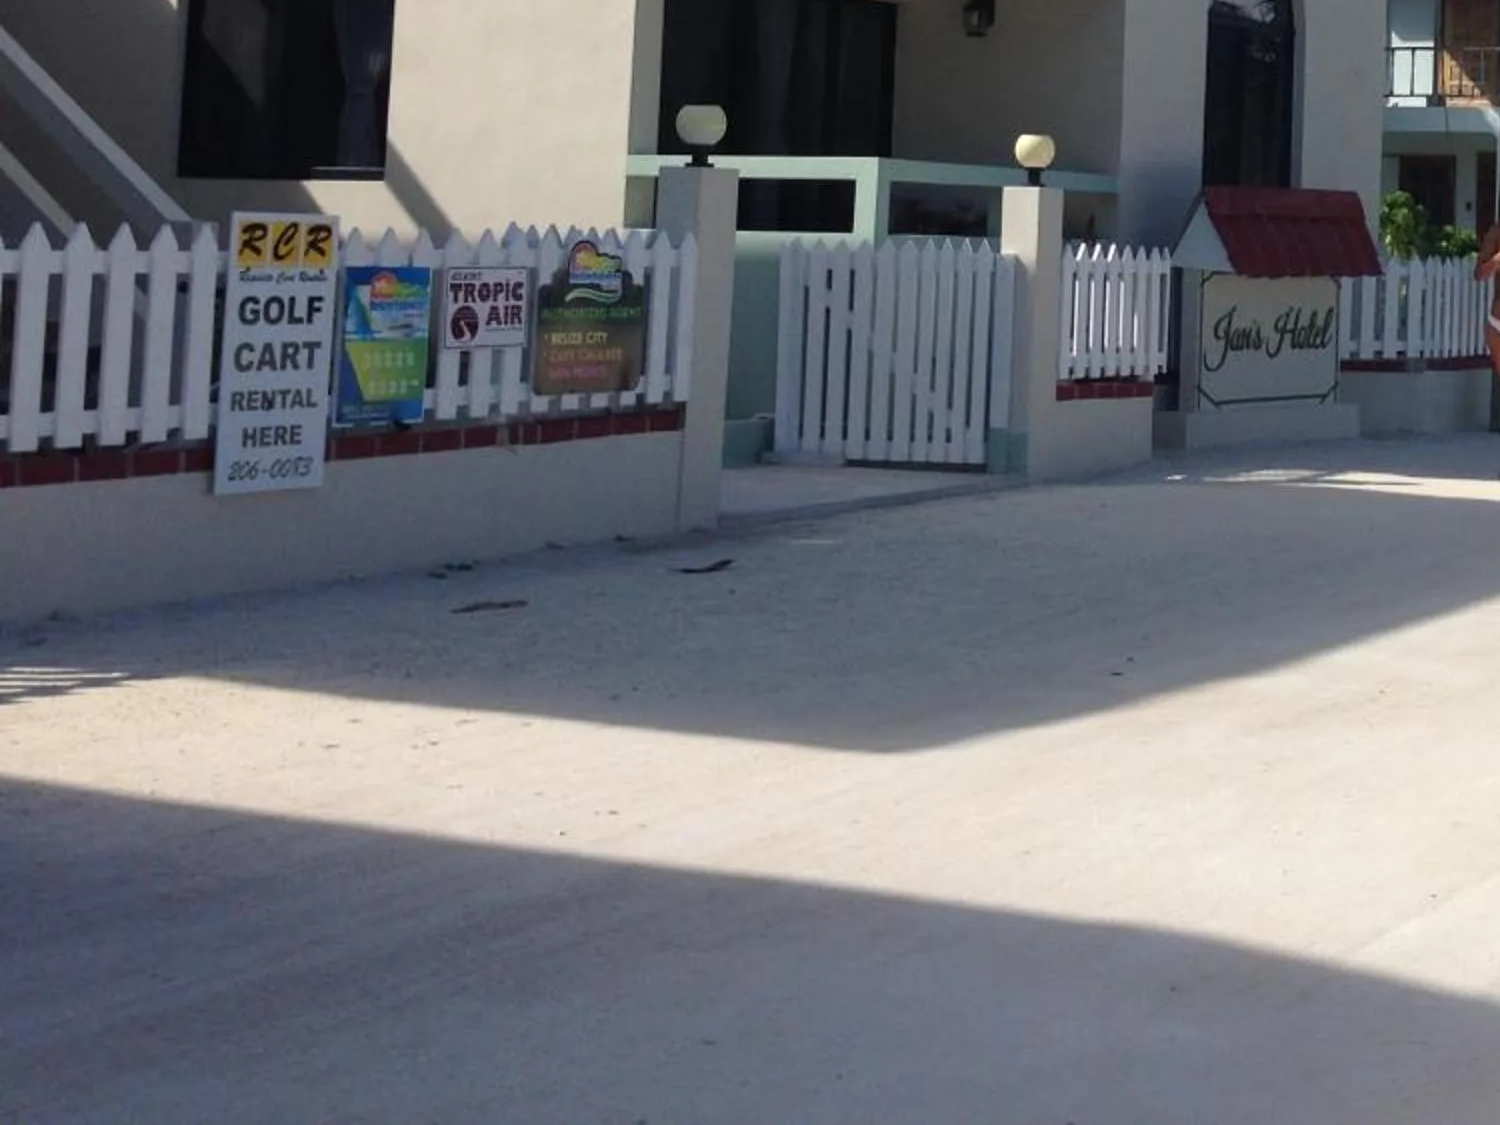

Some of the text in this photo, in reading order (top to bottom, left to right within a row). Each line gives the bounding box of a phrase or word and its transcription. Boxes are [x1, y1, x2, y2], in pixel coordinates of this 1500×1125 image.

[239, 222, 332, 261] RCR
[450, 279, 524, 303] TROPIC
[239, 296, 325, 325] GOLF
[485, 305, 523, 326] AIR
[586, 330, 609, 344] CITY
[1266, 306, 1335, 358] Hotel
[233, 341, 322, 373] CART
[230, 388, 319, 412] RENTAL
[241, 424, 303, 448] HERE
